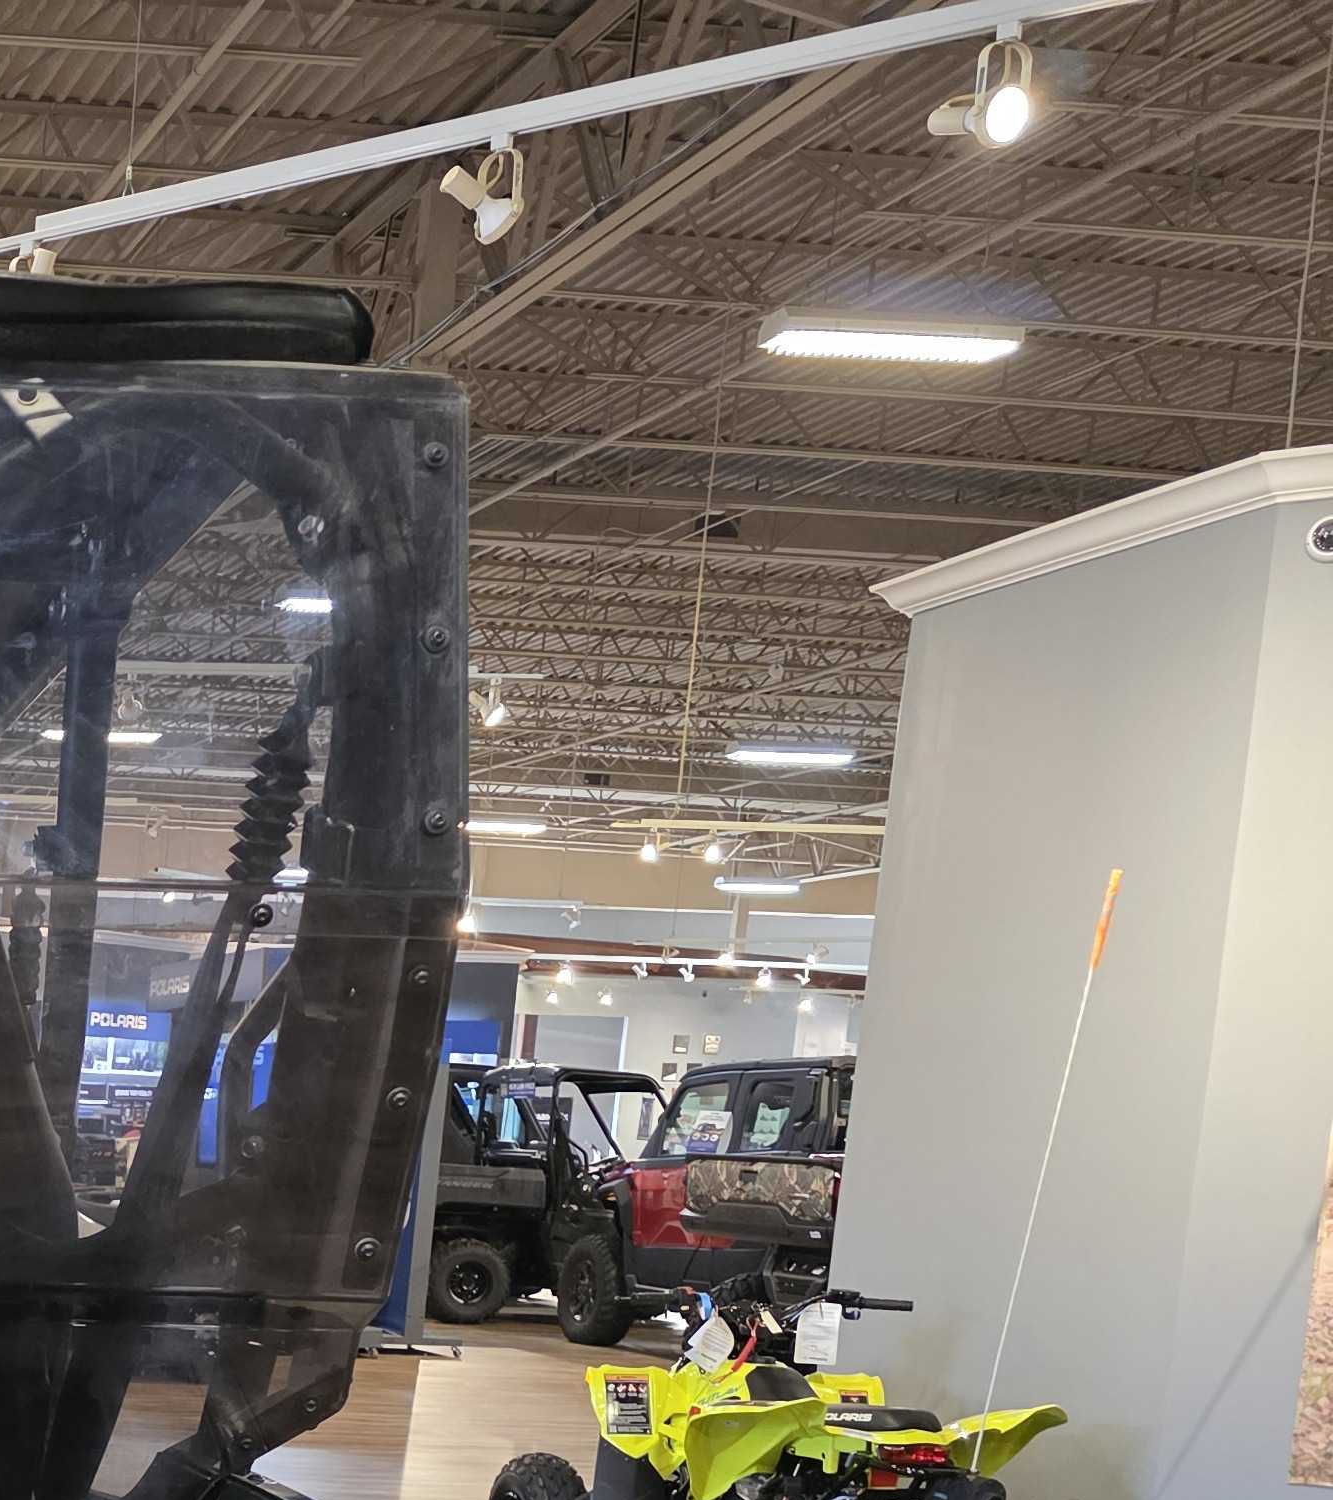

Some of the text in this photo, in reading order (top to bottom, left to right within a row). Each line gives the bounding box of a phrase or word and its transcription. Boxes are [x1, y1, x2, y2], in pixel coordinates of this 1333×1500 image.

[148, 975, 191, 997] POLARIS
[89, 1010, 148, 1031] POLARIS
[823, 1412, 873, 1423] OLARIS
